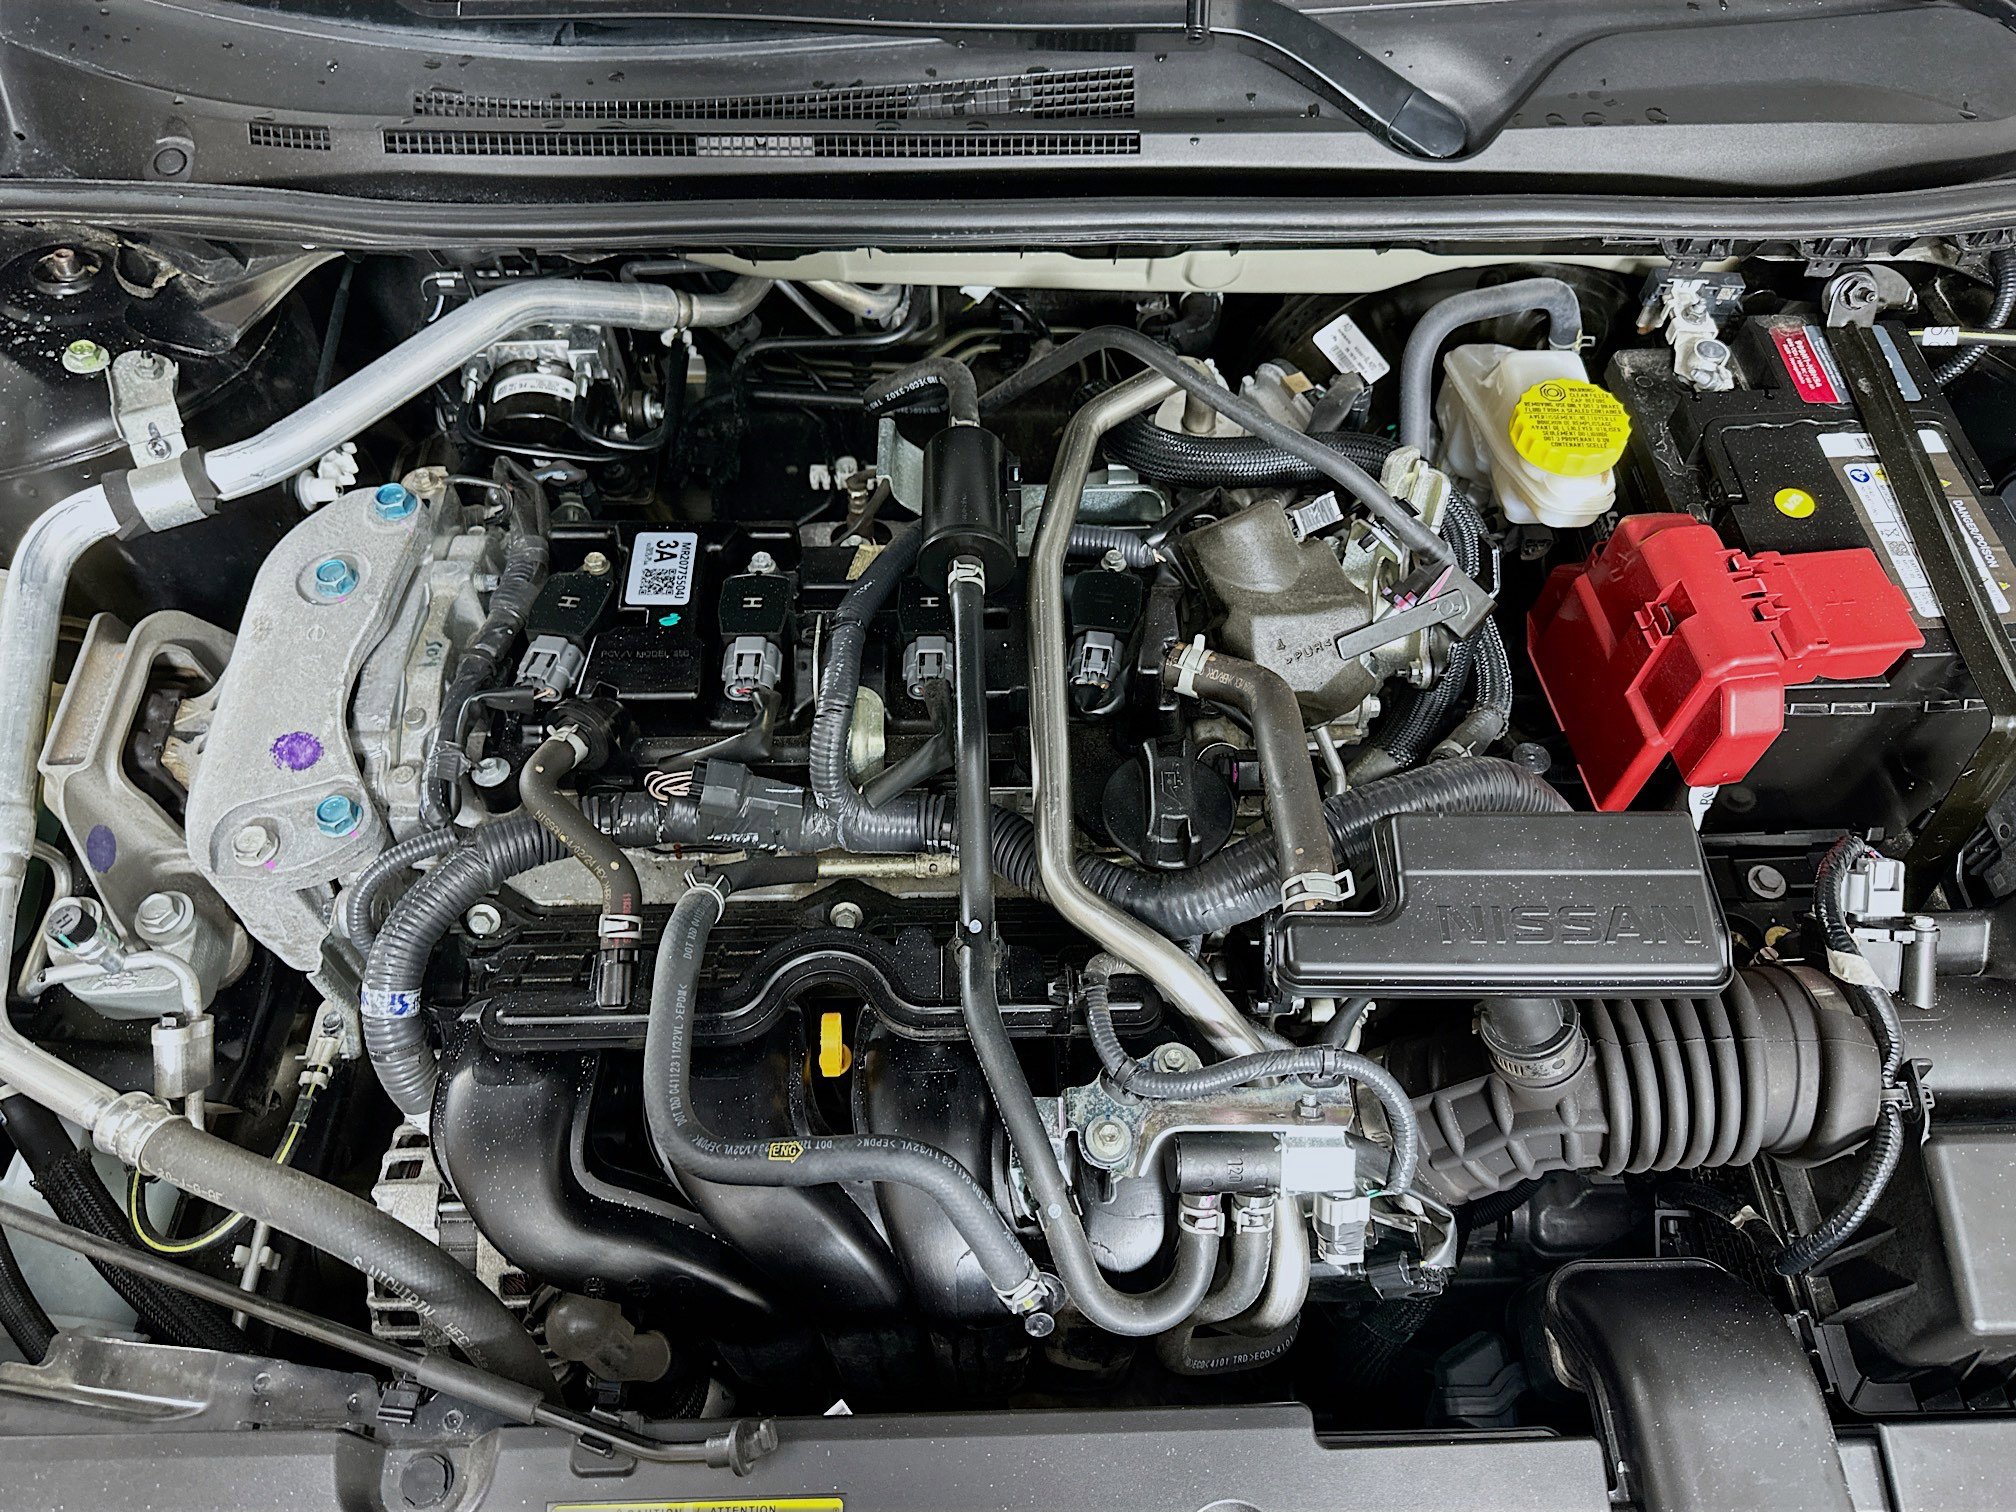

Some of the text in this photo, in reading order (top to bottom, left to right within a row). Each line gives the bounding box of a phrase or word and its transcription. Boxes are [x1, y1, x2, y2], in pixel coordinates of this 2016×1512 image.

[653, 540, 680, 562] 3A
[1436, 905, 1701, 945] NISSAN
[772, 1144, 797, 1157] ENG
